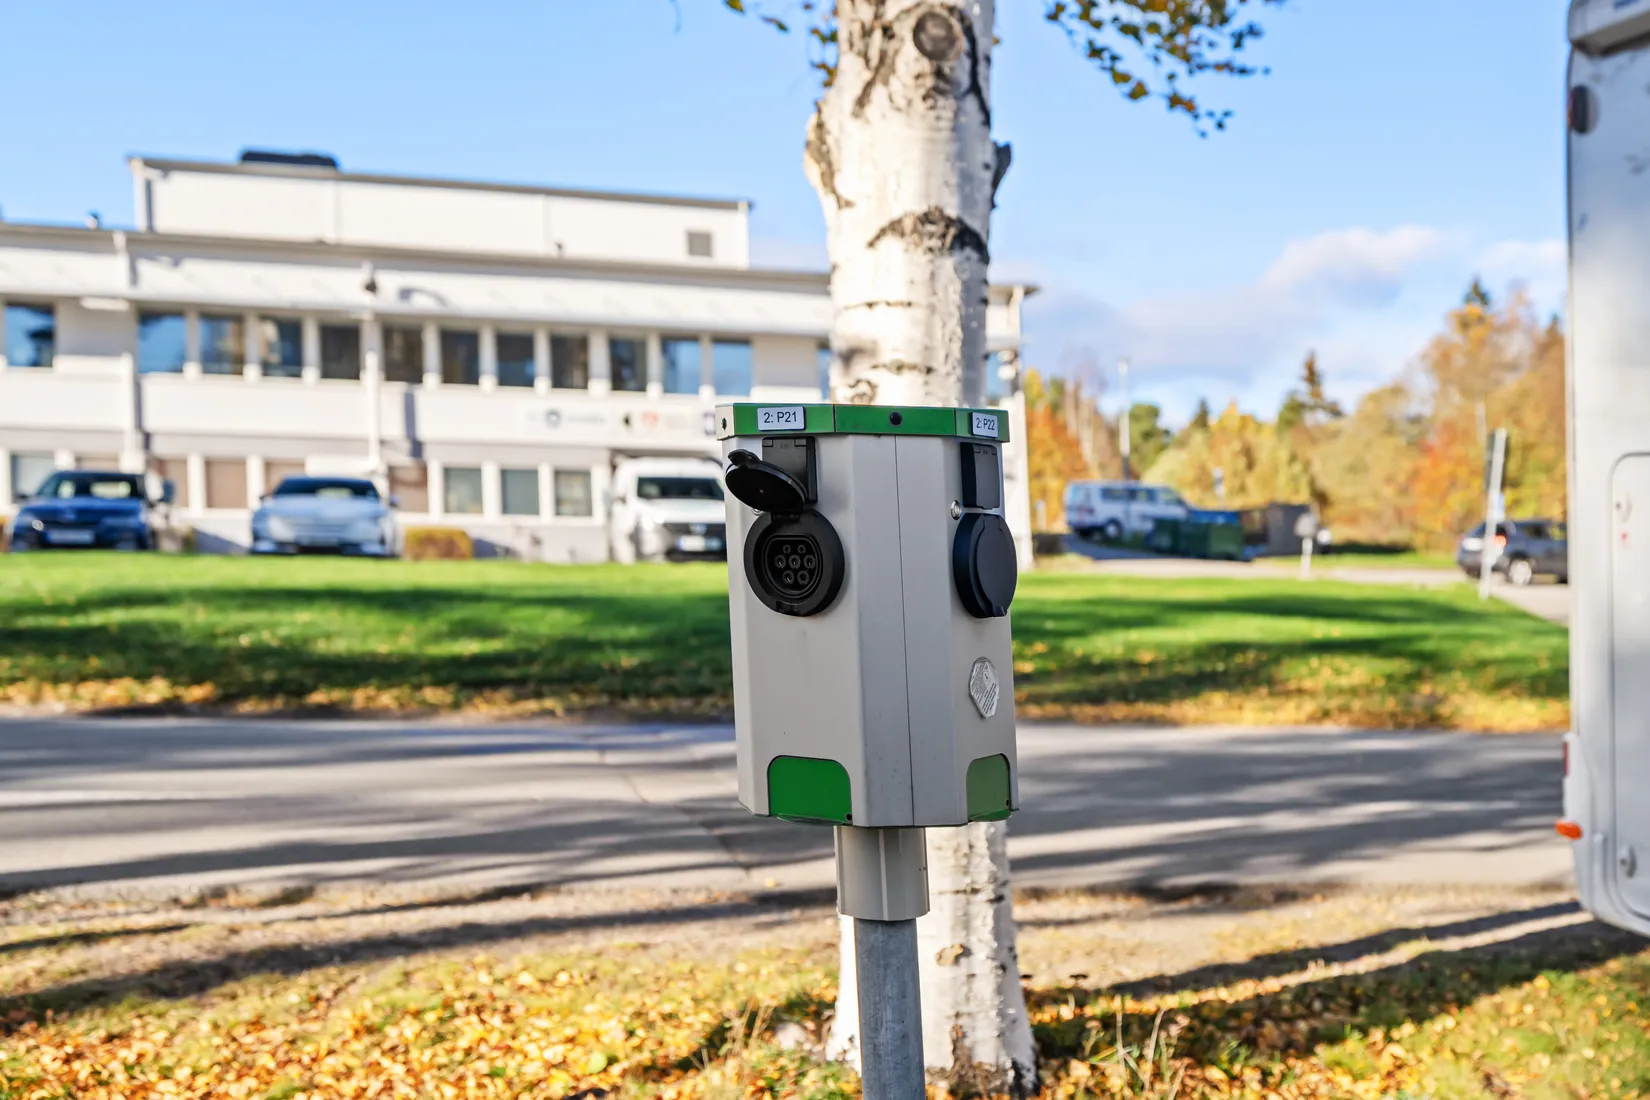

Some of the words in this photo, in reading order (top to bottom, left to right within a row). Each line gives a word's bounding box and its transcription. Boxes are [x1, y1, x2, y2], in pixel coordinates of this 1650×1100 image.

[763, 412, 773, 423] 2:
[777, 411, 797, 423] P21
[983, 418, 995, 430] P22
